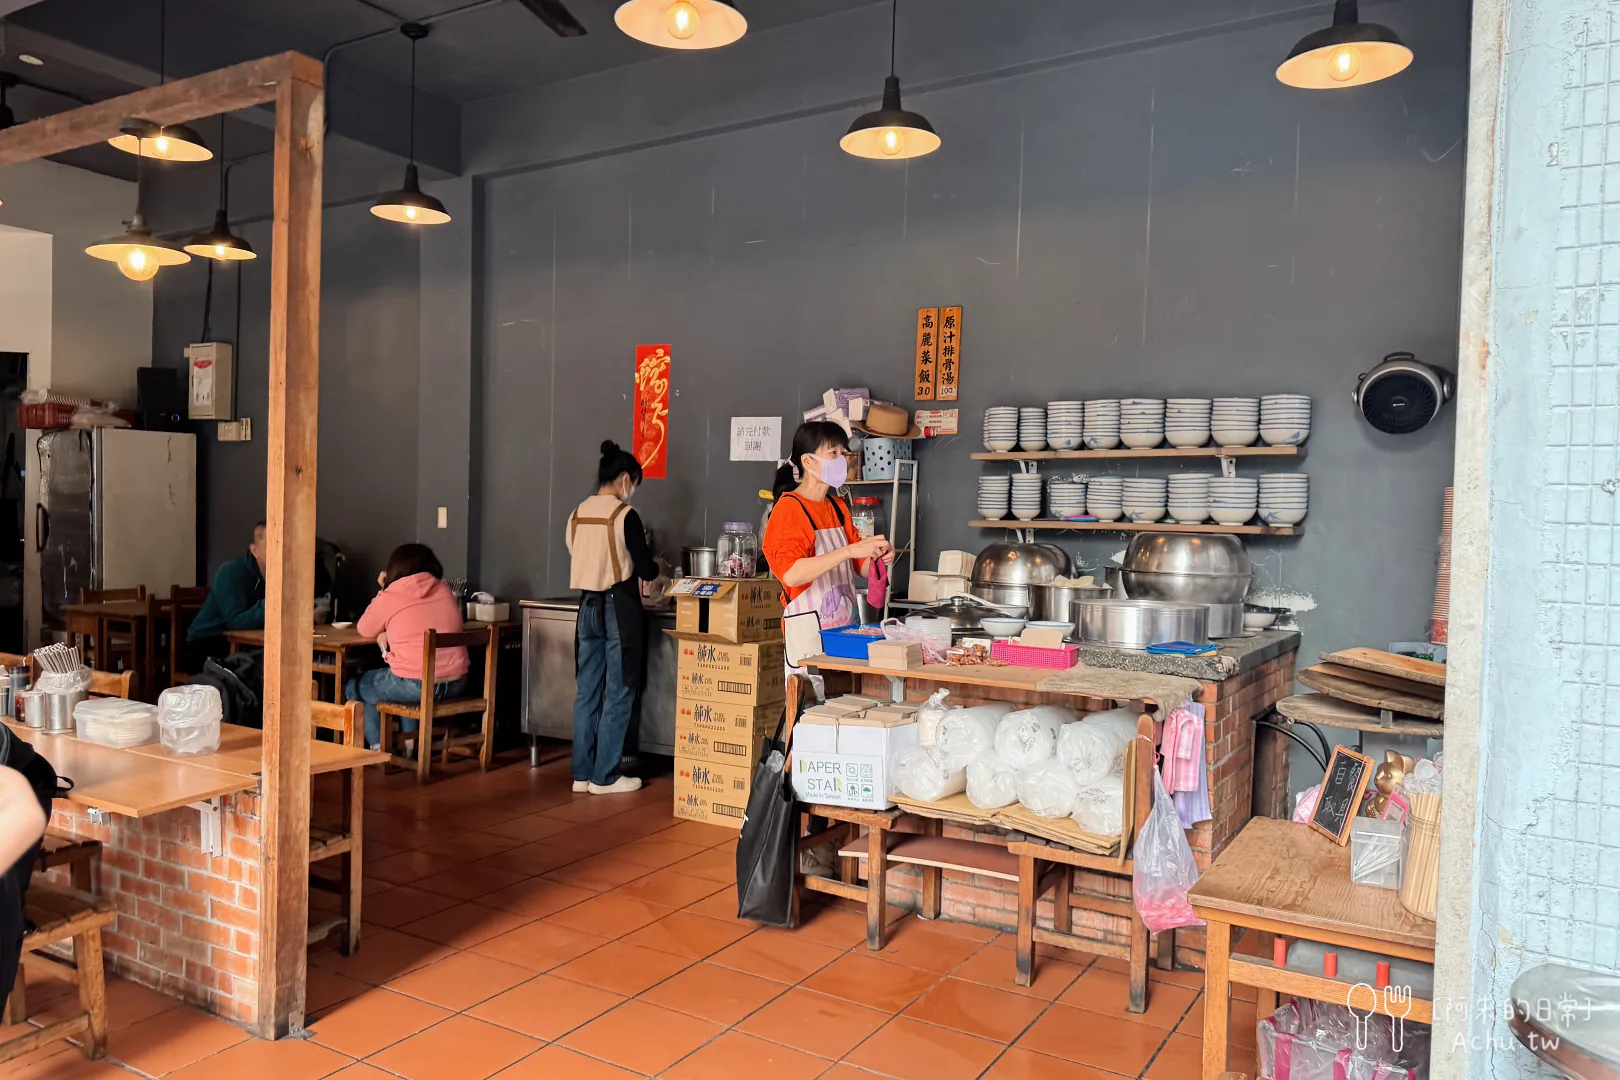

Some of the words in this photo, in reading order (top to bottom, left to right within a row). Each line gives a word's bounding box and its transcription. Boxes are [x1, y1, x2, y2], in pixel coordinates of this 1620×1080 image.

[918, 314, 934, 384] 高麗菜飯
[941, 315, 956, 385] 原汁排骨湯
[917, 386, 931, 396] 30
